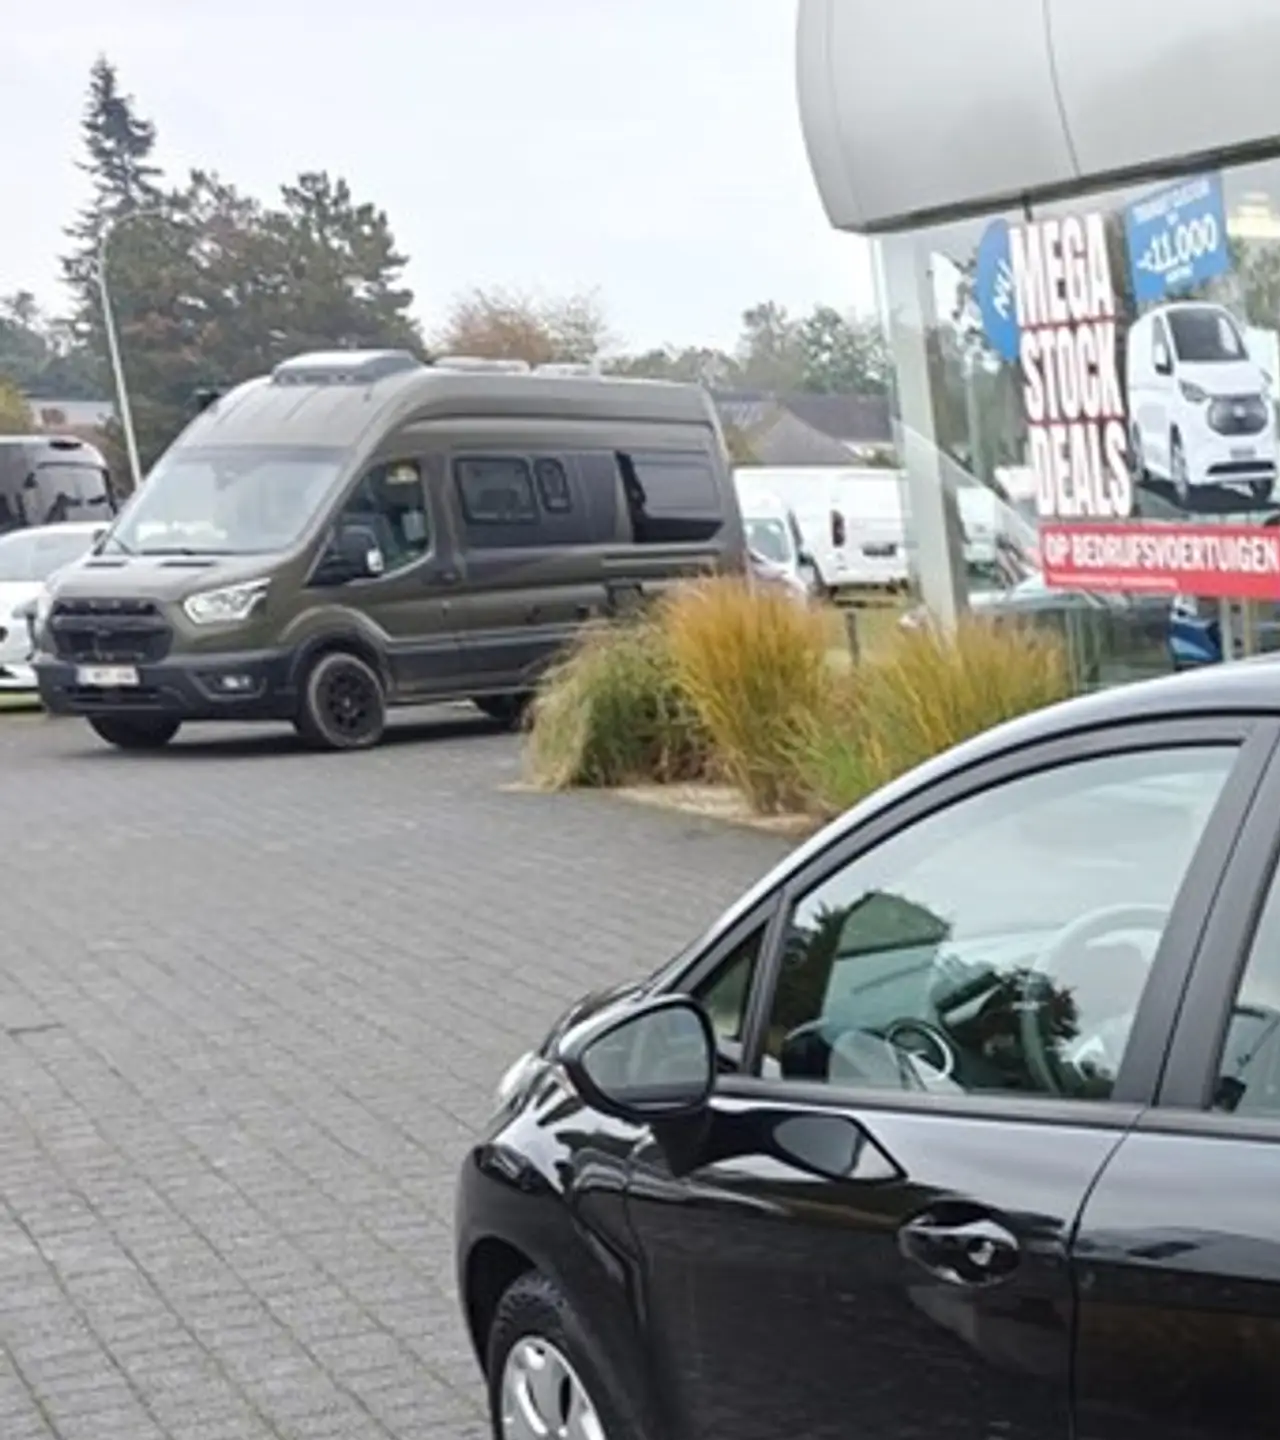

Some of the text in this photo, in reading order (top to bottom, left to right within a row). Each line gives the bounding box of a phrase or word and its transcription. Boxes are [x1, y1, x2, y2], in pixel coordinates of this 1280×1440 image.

[1011, 212, 1115, 328] MEGA
[1019, 322, 1124, 423] STOCK
[1031, 419, 1134, 516] DEALS
[1043, 531, 1071, 566] OP
